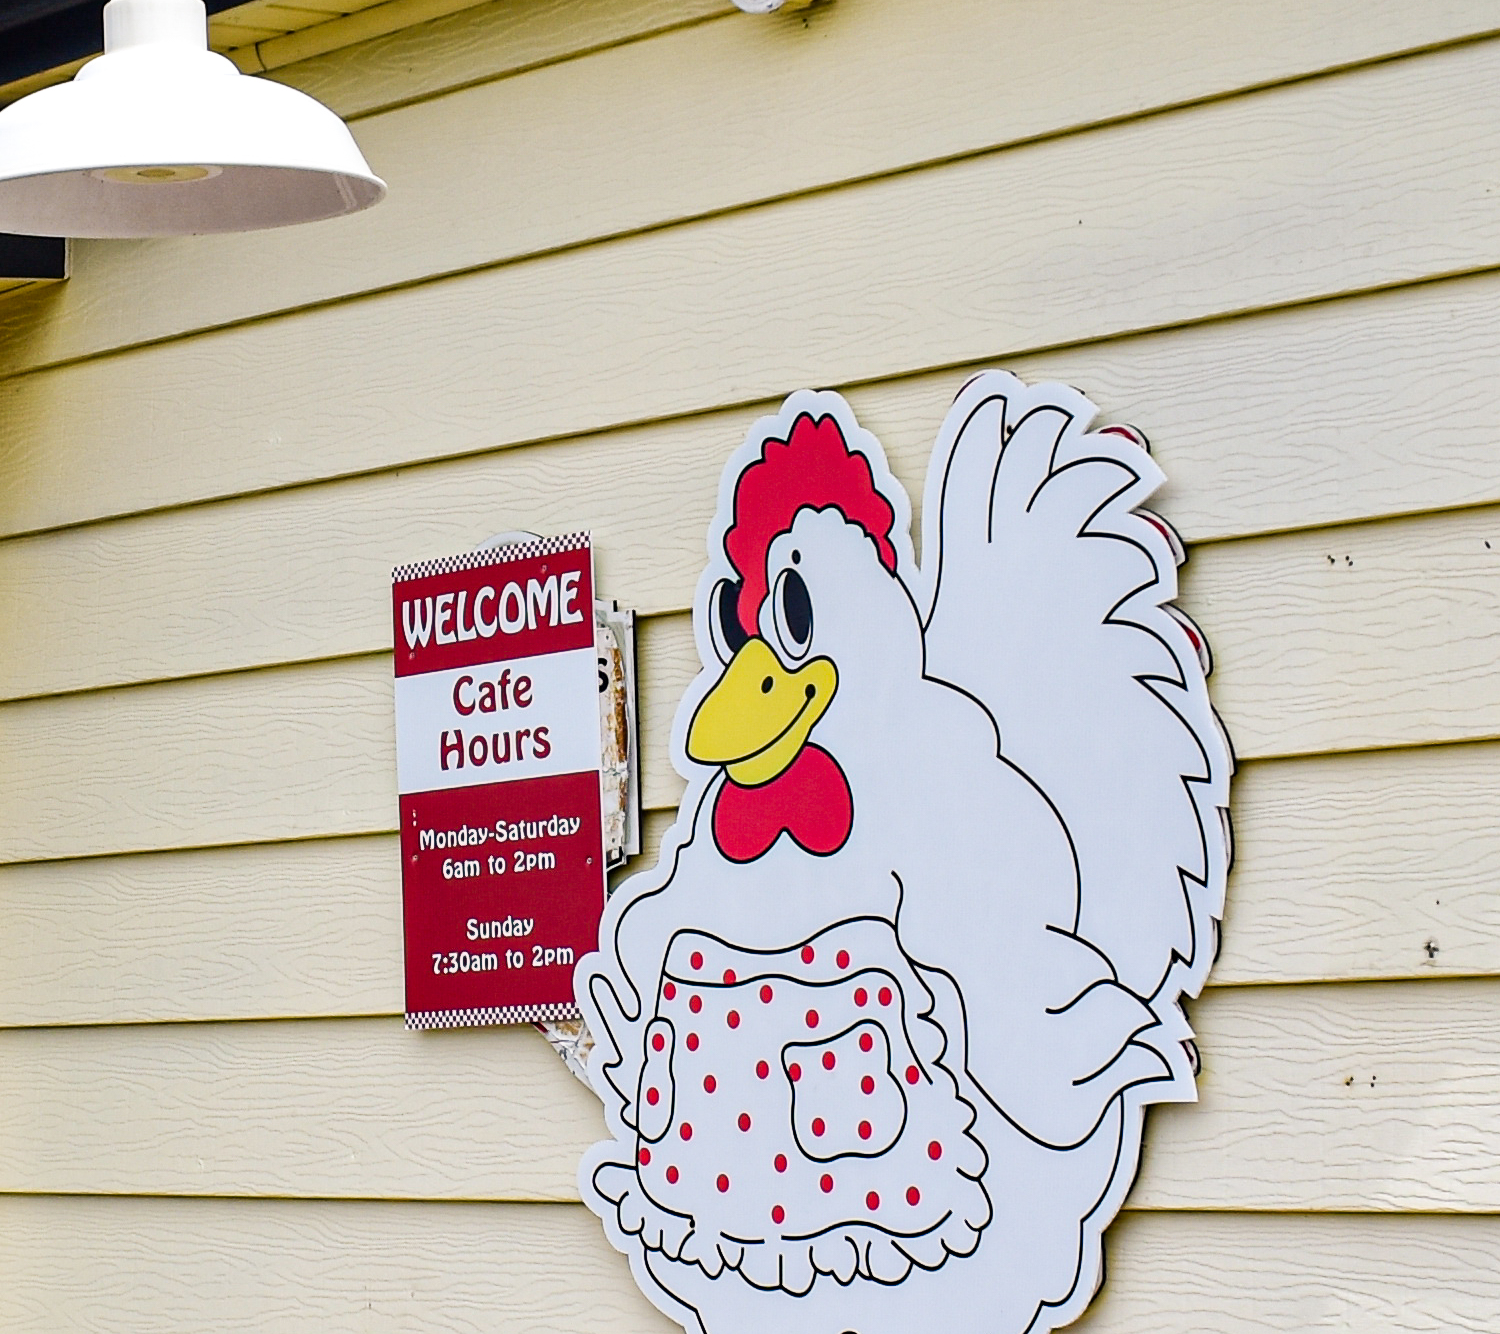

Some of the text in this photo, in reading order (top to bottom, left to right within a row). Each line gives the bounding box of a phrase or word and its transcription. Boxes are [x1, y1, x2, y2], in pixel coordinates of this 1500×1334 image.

[402, 570, 584, 650] WELCOME
[452, 668, 533, 716] Cafe
[440, 726, 552, 771] Hours
[419, 814, 581, 851] Monday-Saturday
[442, 850, 556, 879] 6am to 2pm
[466, 915, 534, 941] Sunday
[431, 945, 574, 975] 7:30am to 2pm
